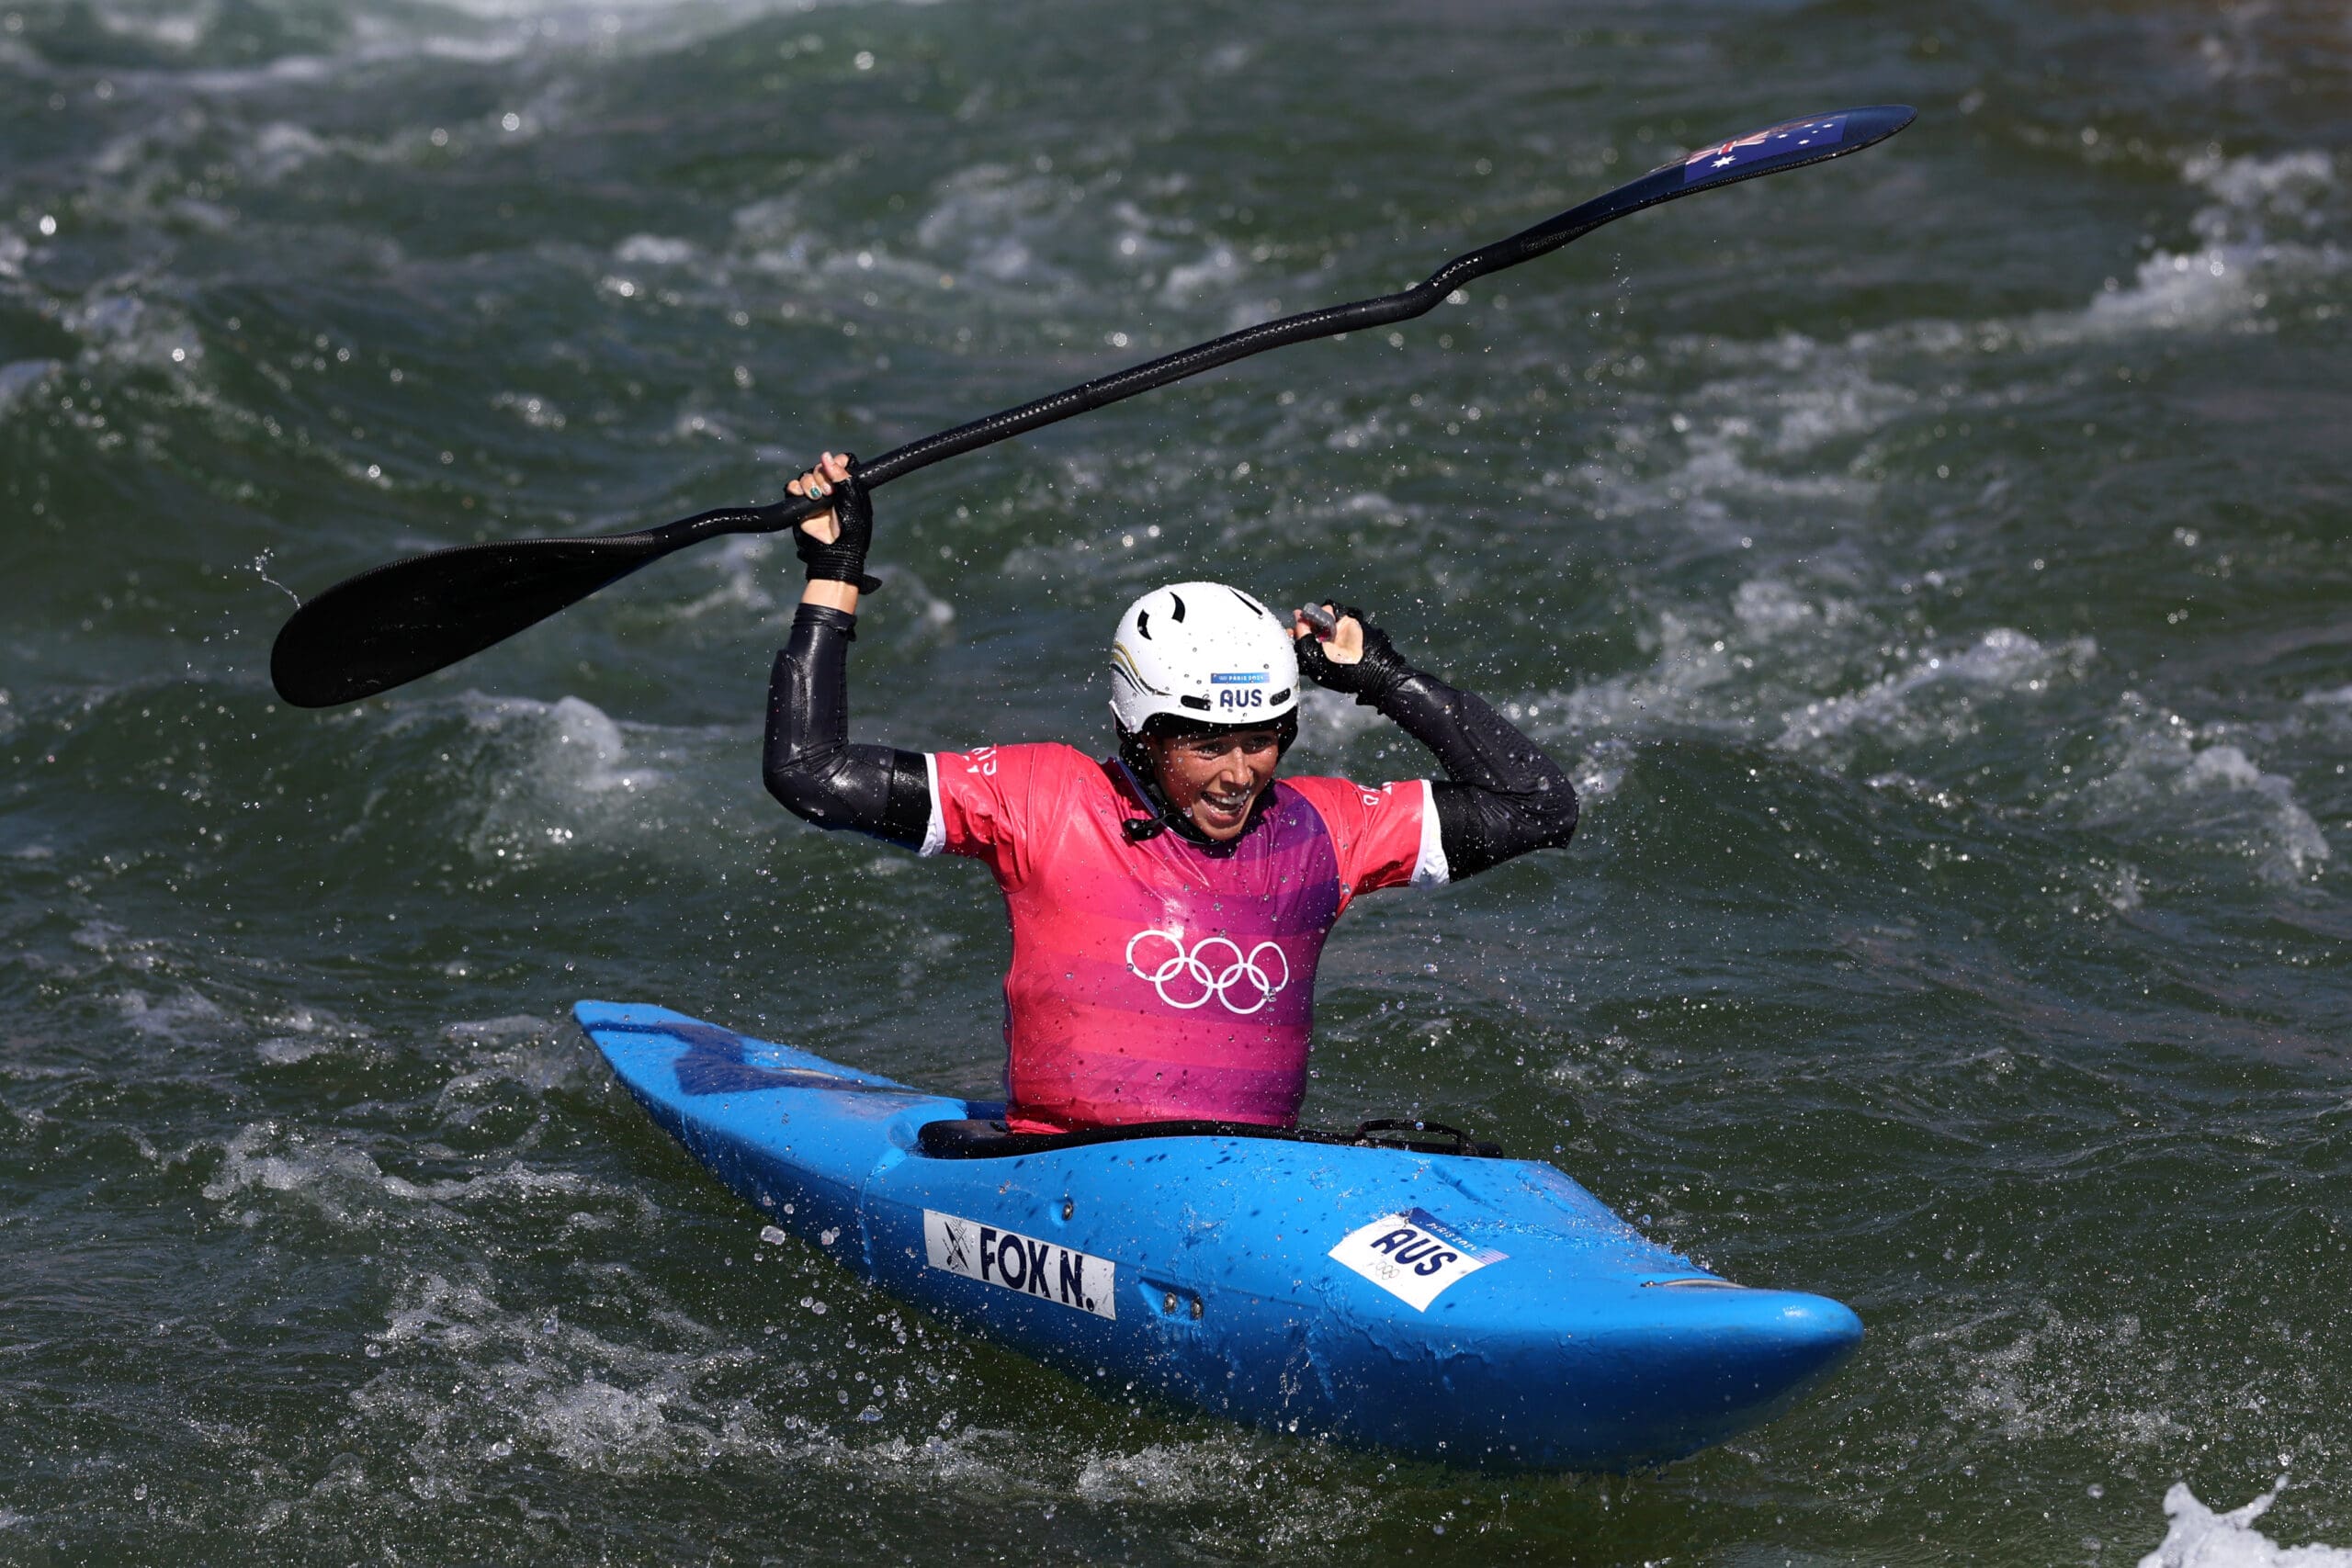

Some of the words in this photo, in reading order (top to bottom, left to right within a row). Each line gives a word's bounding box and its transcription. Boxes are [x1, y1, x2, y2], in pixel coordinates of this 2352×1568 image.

[1219, 689, 1262, 707] AUS
[1370, 1228, 1458, 1276] AUS
[1426, 1223, 1455, 1238] PARIS
[1452, 1236, 1477, 1251] 2024
[979, 1226, 1051, 1299] FOX
[1059, 1249, 1095, 1313] N.
